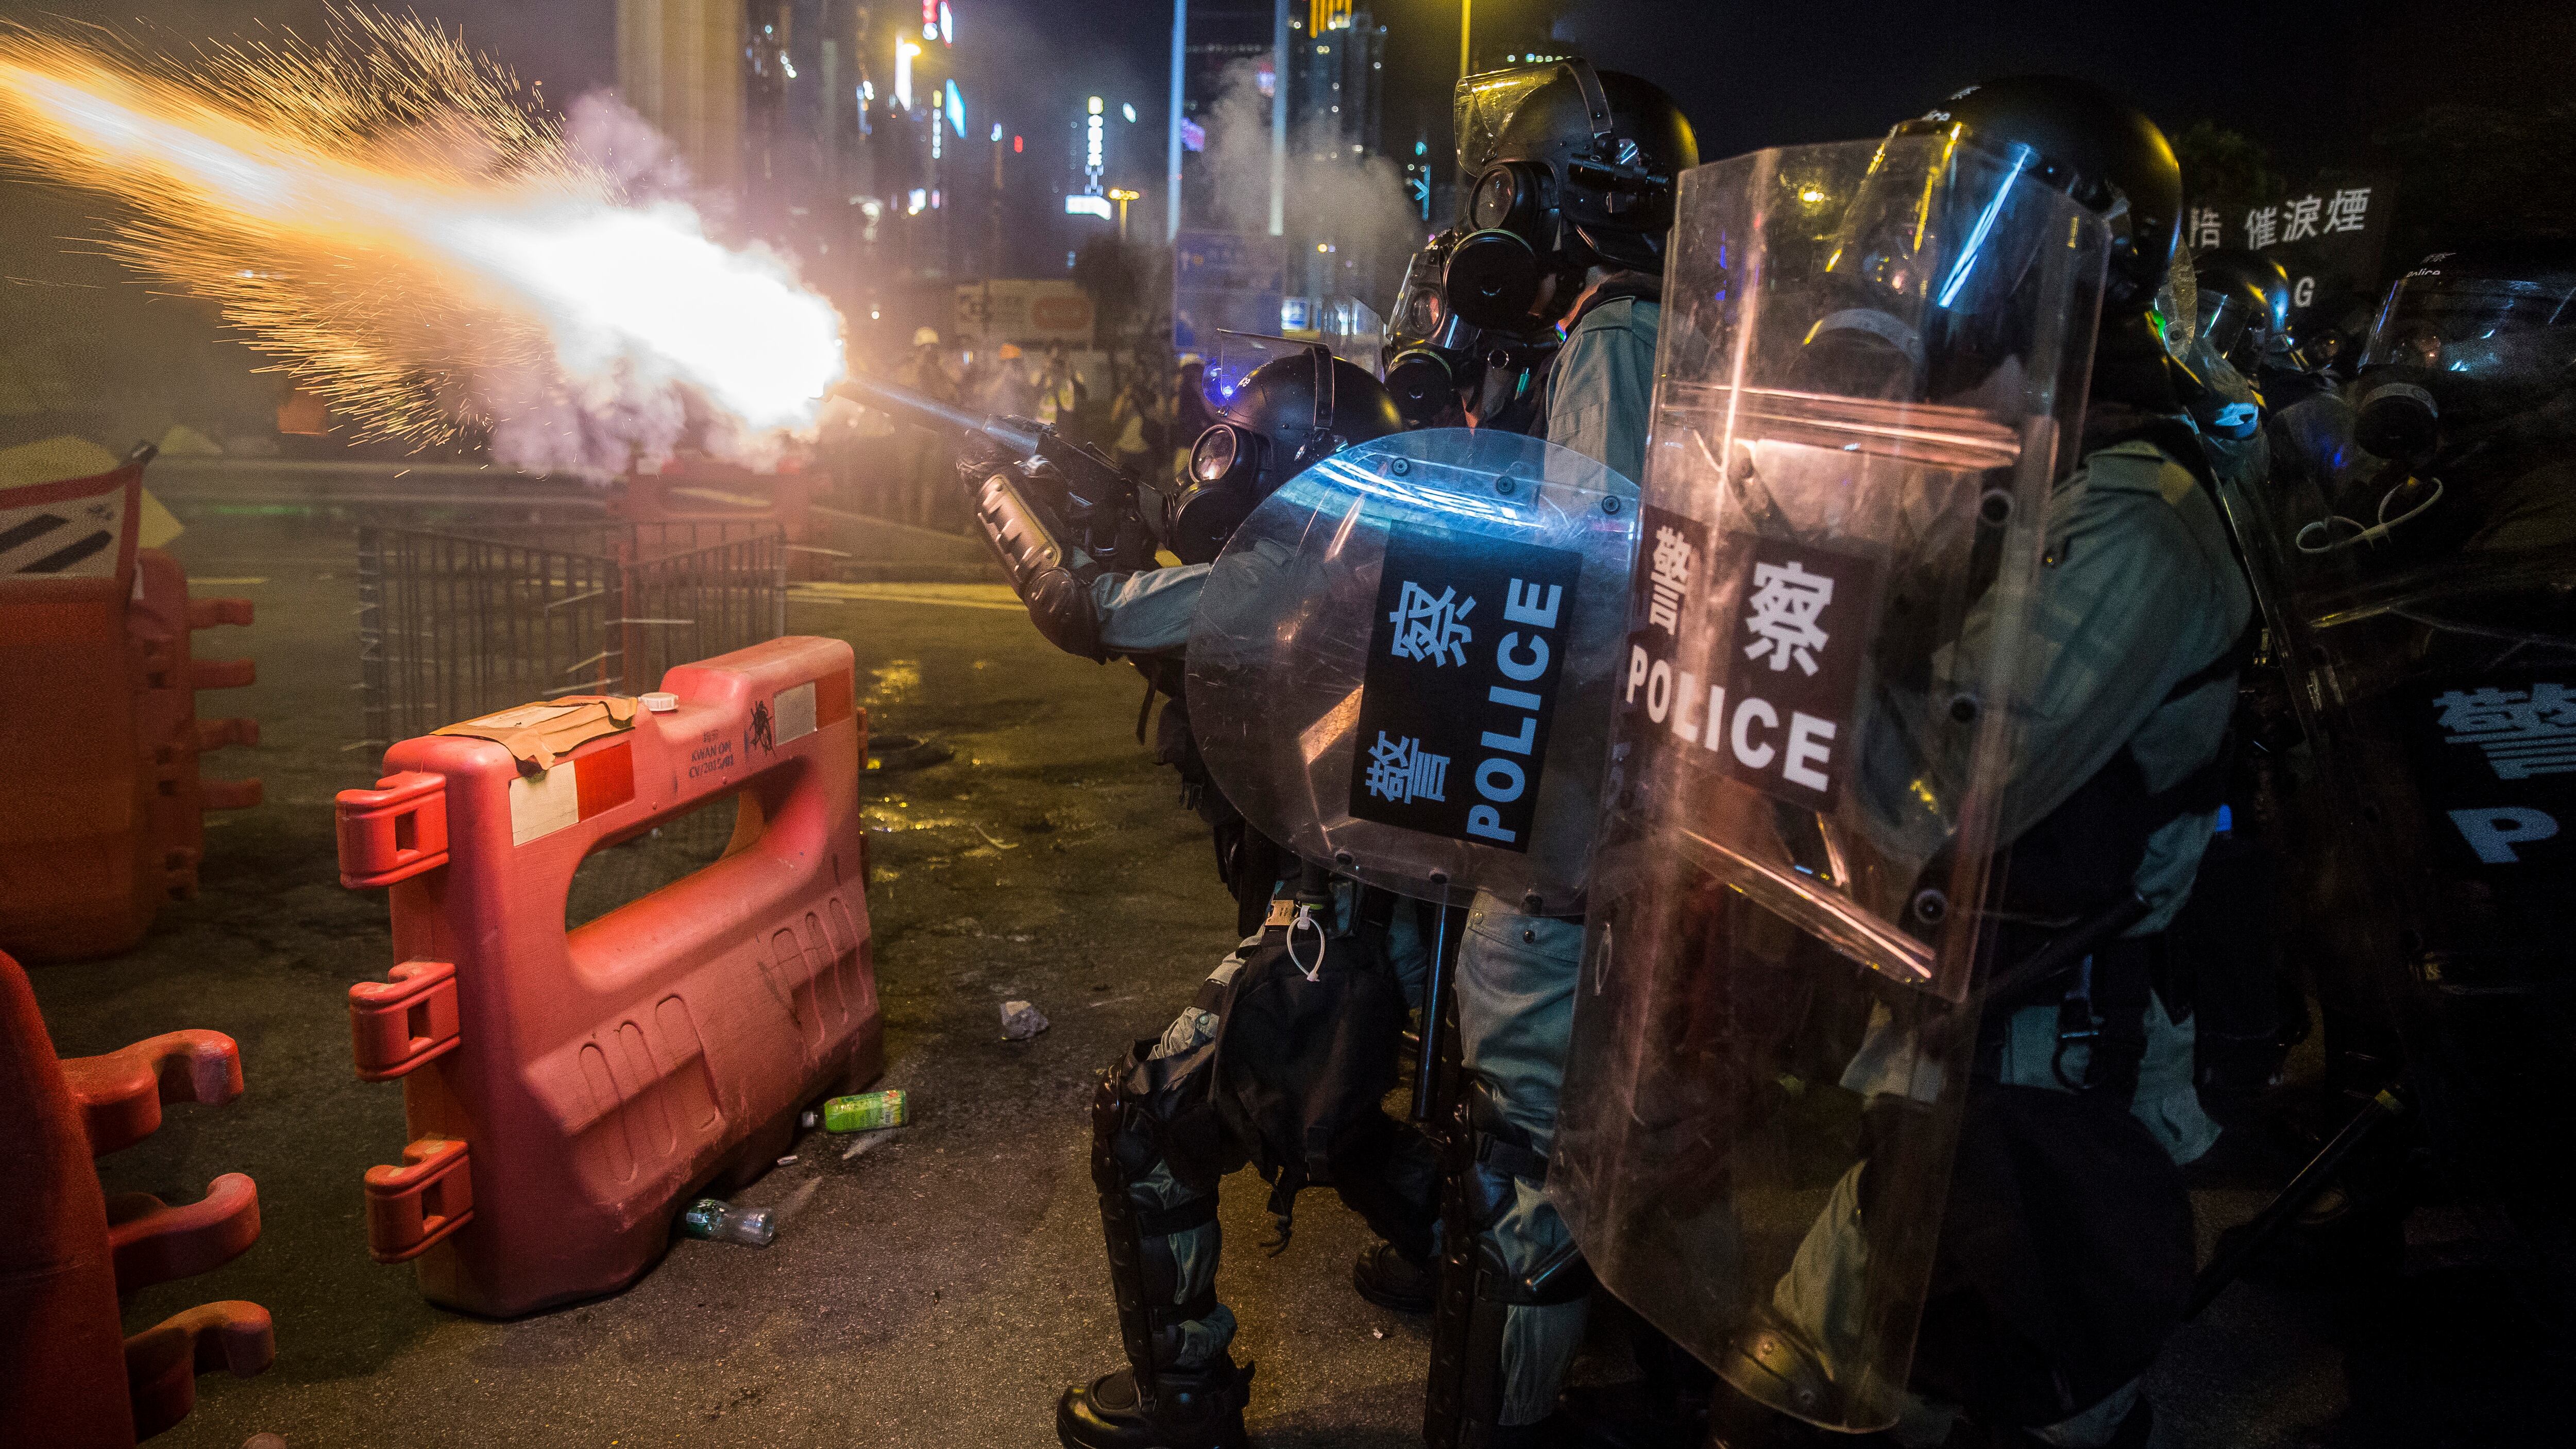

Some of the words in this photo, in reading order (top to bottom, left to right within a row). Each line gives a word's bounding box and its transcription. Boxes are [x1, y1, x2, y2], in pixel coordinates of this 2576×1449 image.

[2244, 187, 2371, 250] 催淚煙
[1466, 578, 1562, 843] POLICE
[1626, 644, 1836, 793] POLICE
